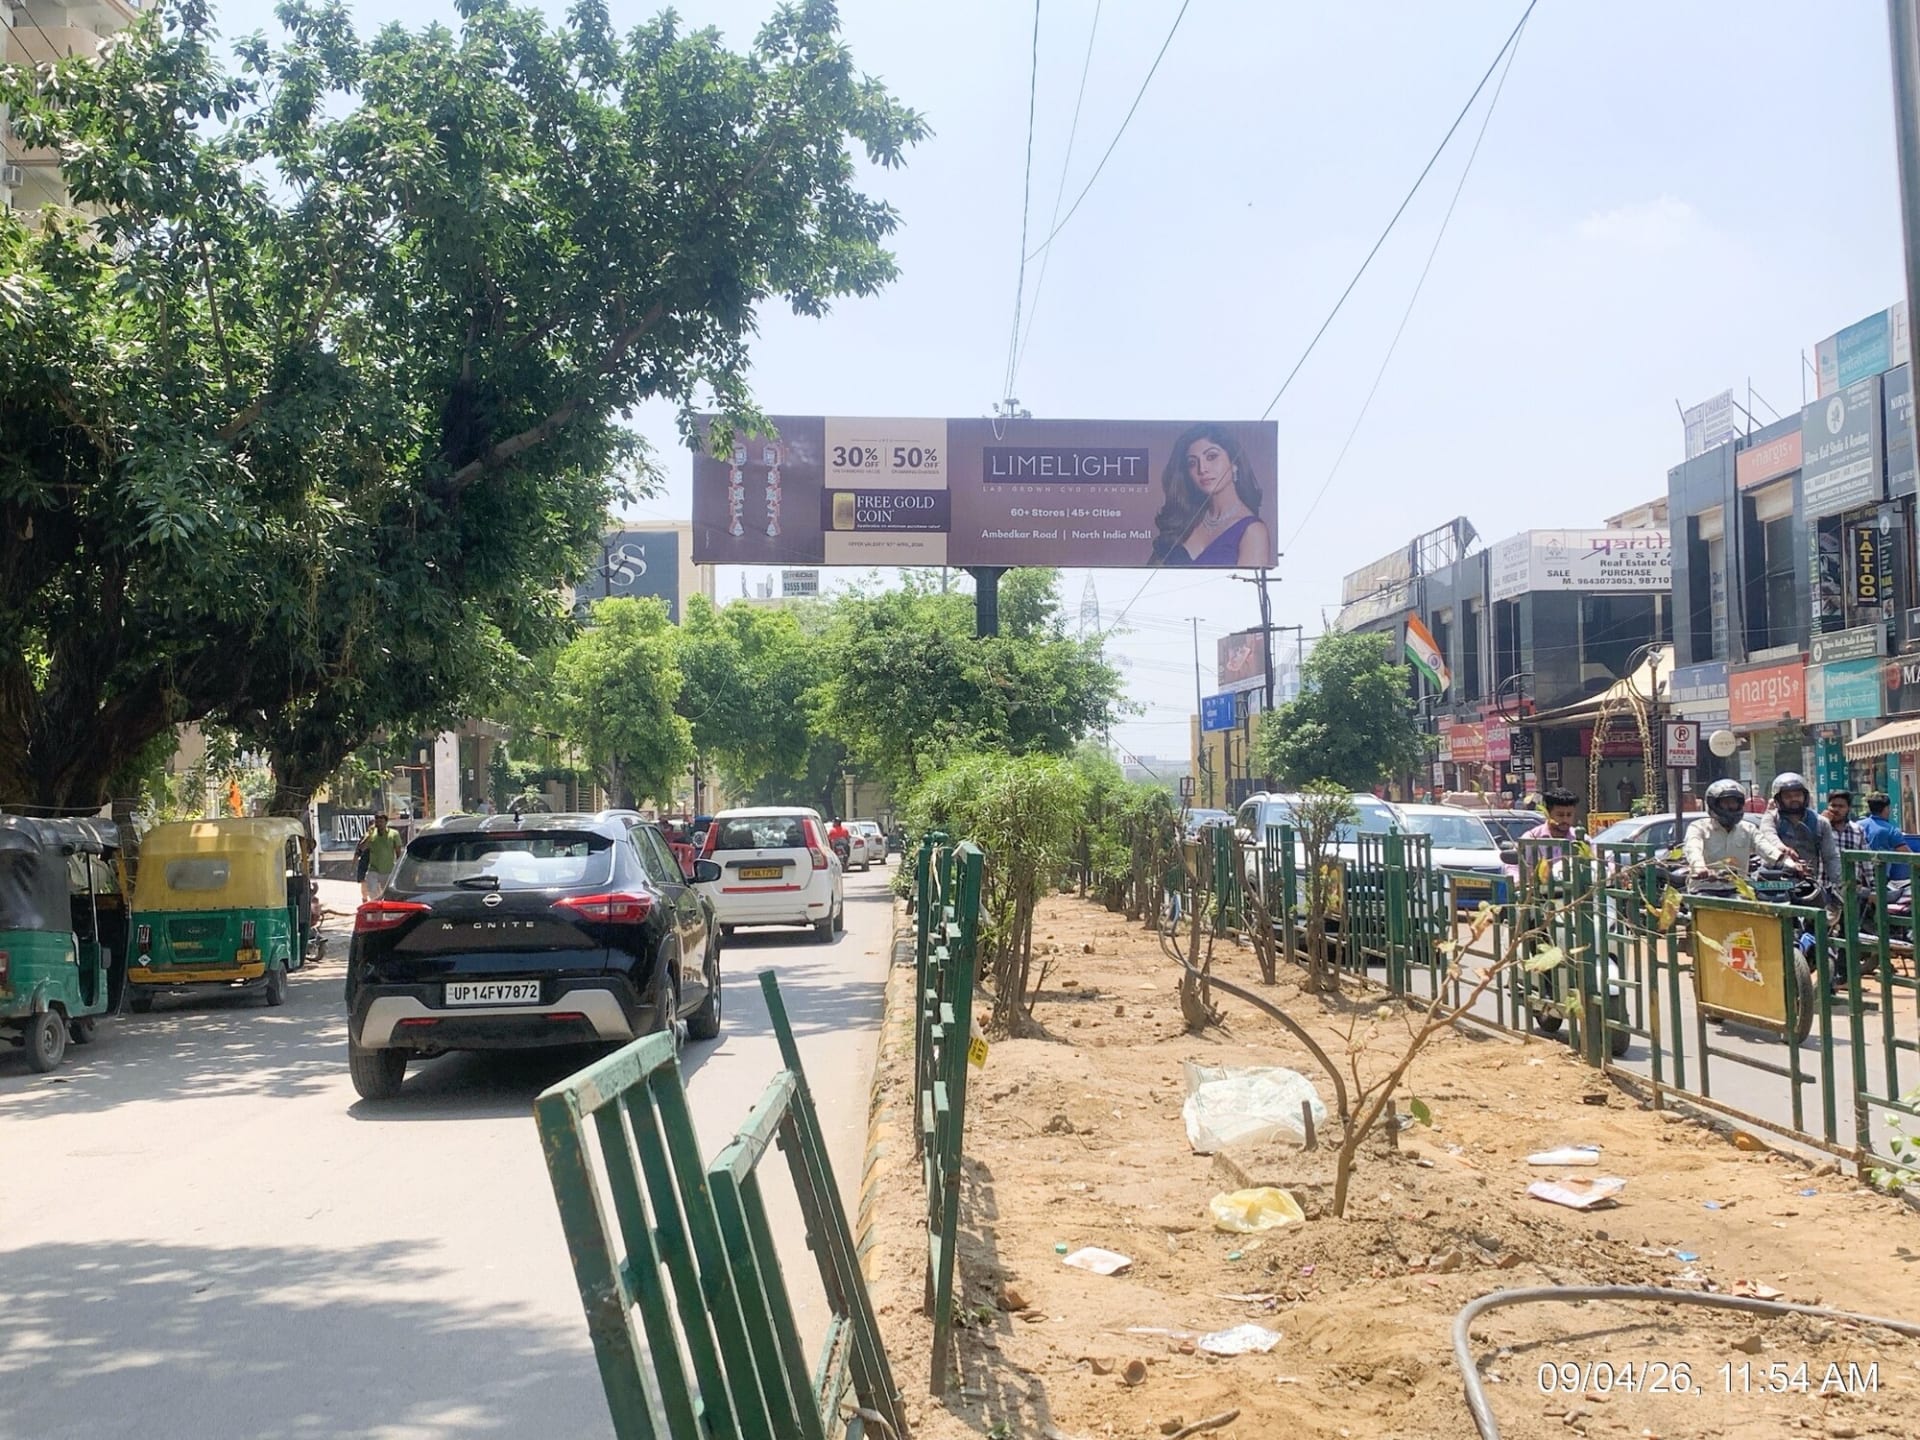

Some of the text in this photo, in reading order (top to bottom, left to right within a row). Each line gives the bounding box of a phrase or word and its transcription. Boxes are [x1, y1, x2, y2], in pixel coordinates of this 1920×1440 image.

[992, 454, 1141, 476] LIMELIGHT
[857, 496, 935, 509] FREE GOLD
[1010, 508, 1121, 517] 60+ Stores 45+ Cities
[982, 530, 1151, 539] Ambedkar Road North India Mall
[1859, 530, 1876, 596] TATTOO
[1741, 670, 1790, 706] nargis
[454, 985, 537, 1000] UP14FV7872
